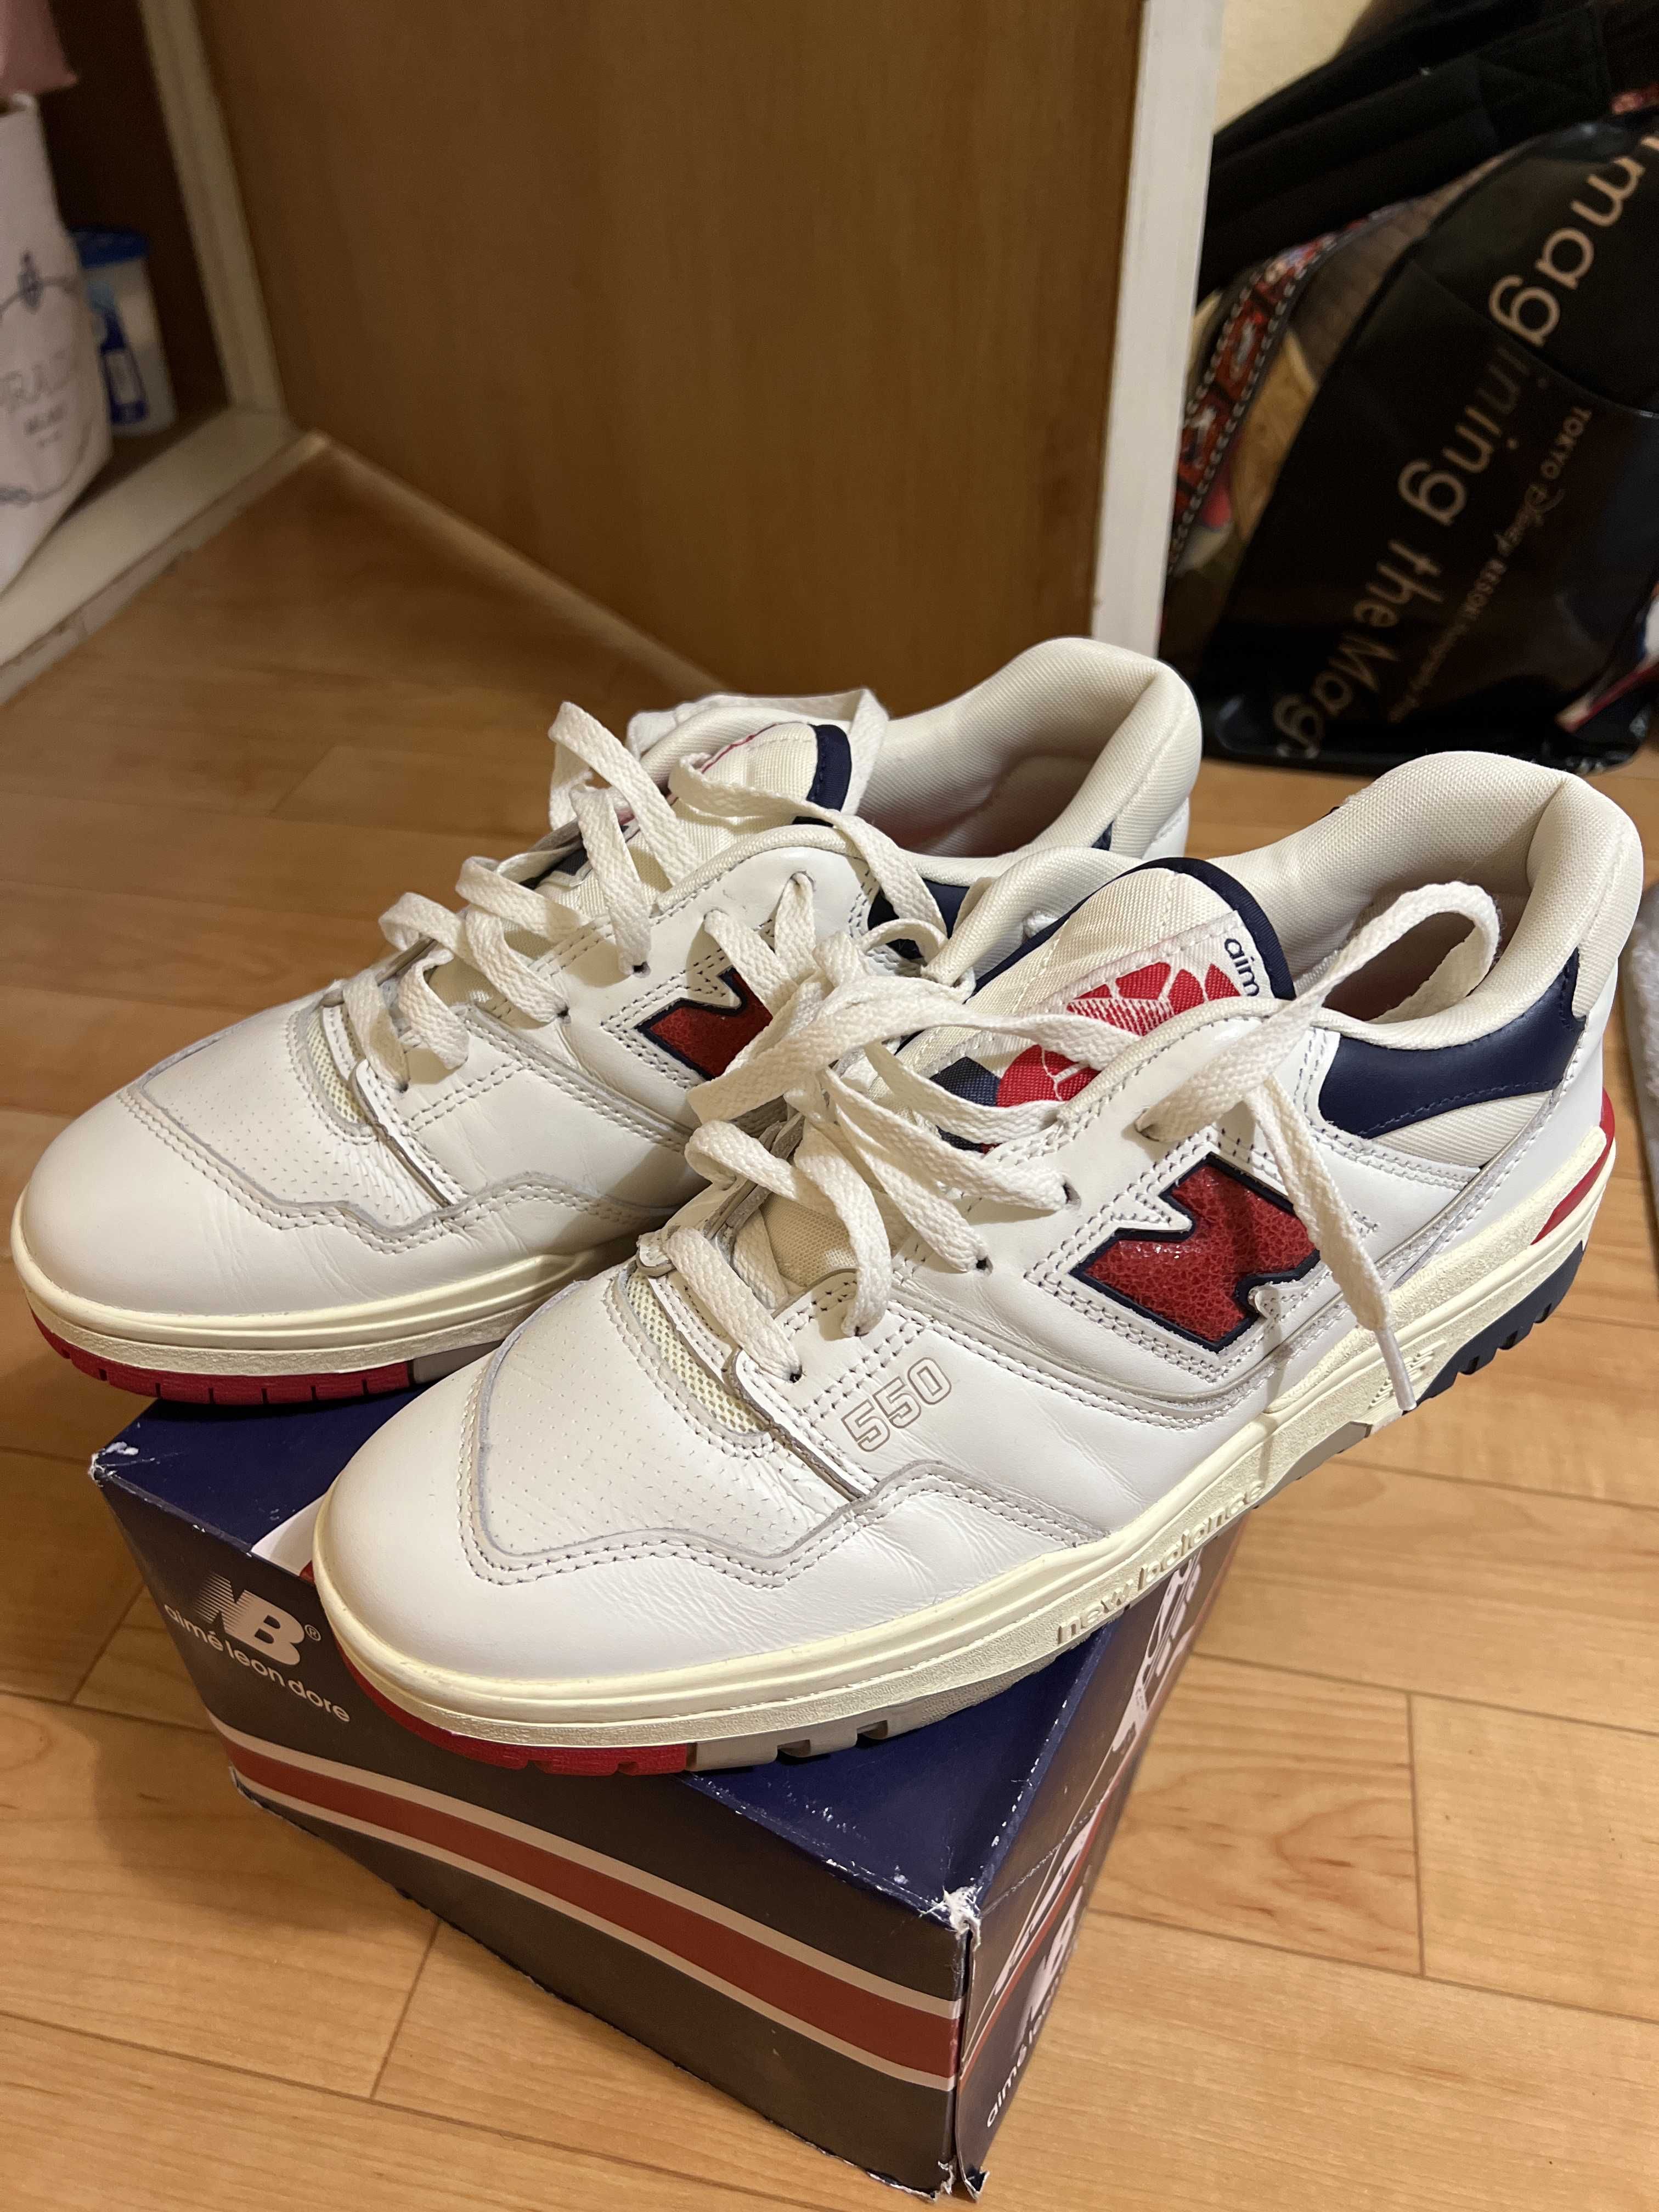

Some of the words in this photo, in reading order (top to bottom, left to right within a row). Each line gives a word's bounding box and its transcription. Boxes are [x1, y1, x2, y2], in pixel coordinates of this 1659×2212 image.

[1398, 135, 1659, 527] magining
[1541, 407, 1591, 479] TOKYO
[1353, 539, 1444, 628] the
[1273, 630, 1401, 758] Mag
[1224, 938, 1260, 996] aim
[841, 1357, 952, 1452] 550
[1057, 1579, 1134, 1645] new
[1138, 1480, 1264, 1590] balance
[226, 1639, 284, 1687] leon
[288, 1679, 350, 1723] dore
